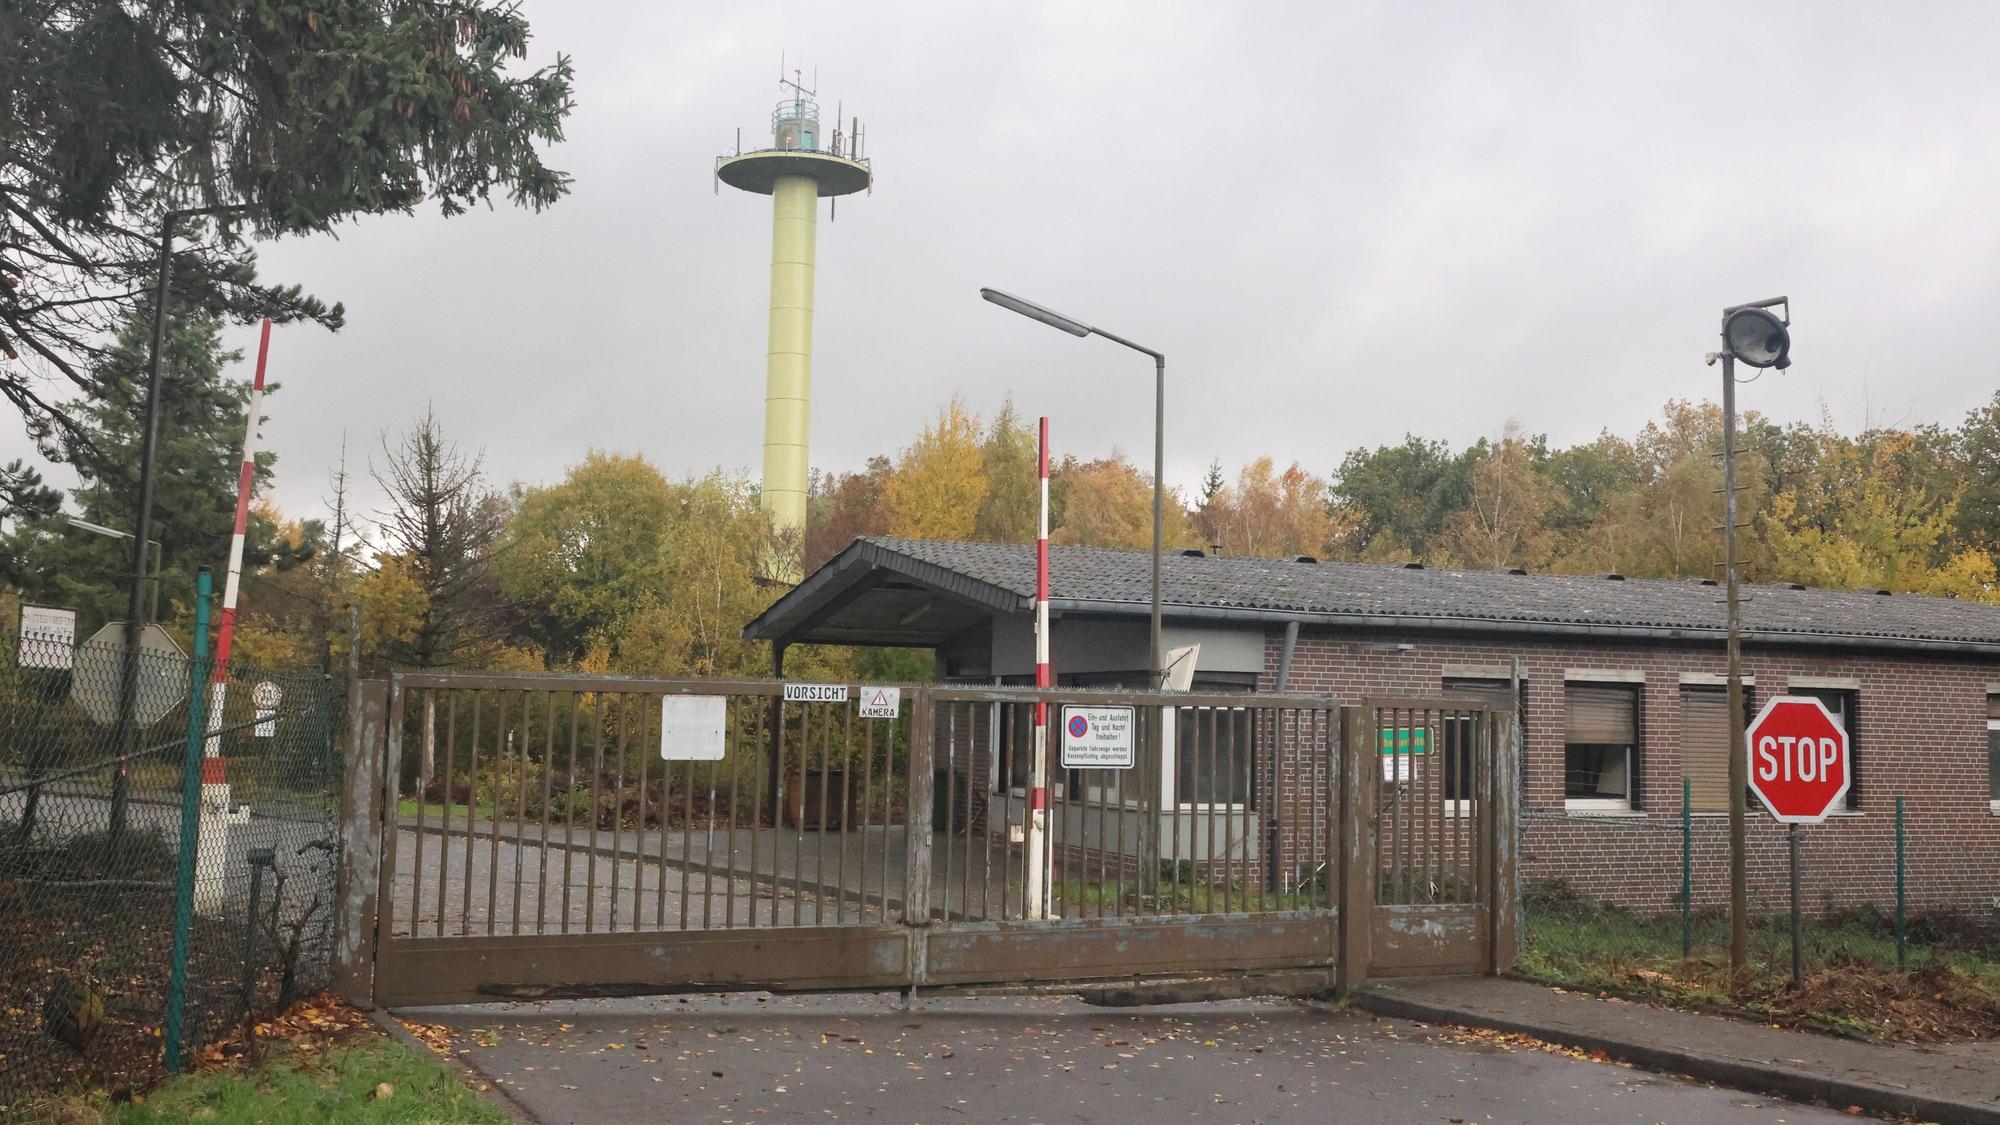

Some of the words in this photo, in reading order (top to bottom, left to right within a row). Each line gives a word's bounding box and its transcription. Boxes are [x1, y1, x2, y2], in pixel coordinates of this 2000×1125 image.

[786, 686, 846, 700] VORSICHT
[862, 708, 895, 717] KAMERA
[1088, 713, 1098, 721] Ein-
[1092, 723, 1100, 732] Tag
[1759, 735, 1837, 783] STOP
